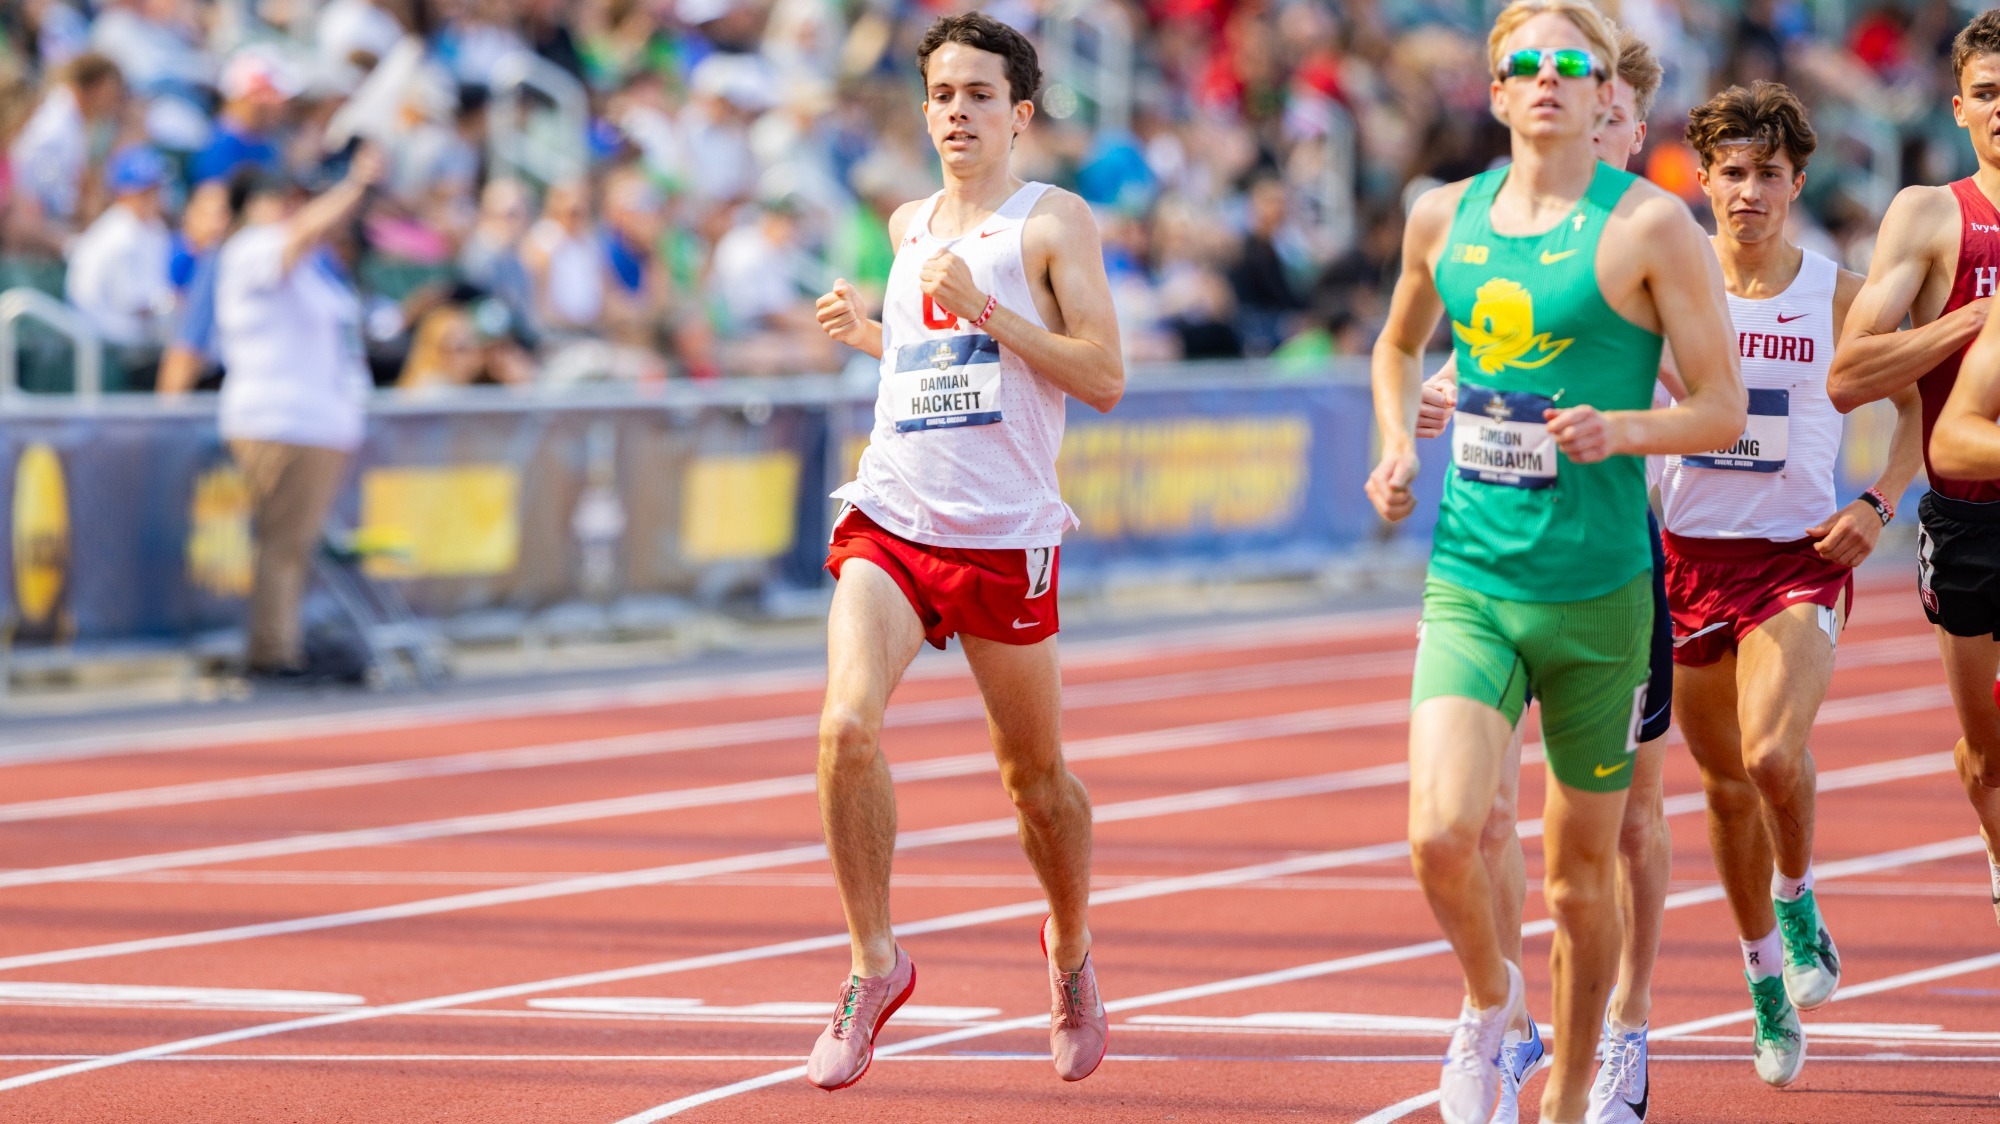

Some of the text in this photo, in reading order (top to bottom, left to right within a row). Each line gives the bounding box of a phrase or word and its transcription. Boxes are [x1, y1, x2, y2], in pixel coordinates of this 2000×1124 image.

[1971, 222, 1990, 234] Ivy
[920, 374, 969, 392] DAMIAN
[911, 391, 981, 415] HACKETT
[1479, 426, 1522, 446] SIMEON
[1462, 442, 1543, 471] BIRNBAUM
[1710, 439, 1760, 457] UNG
